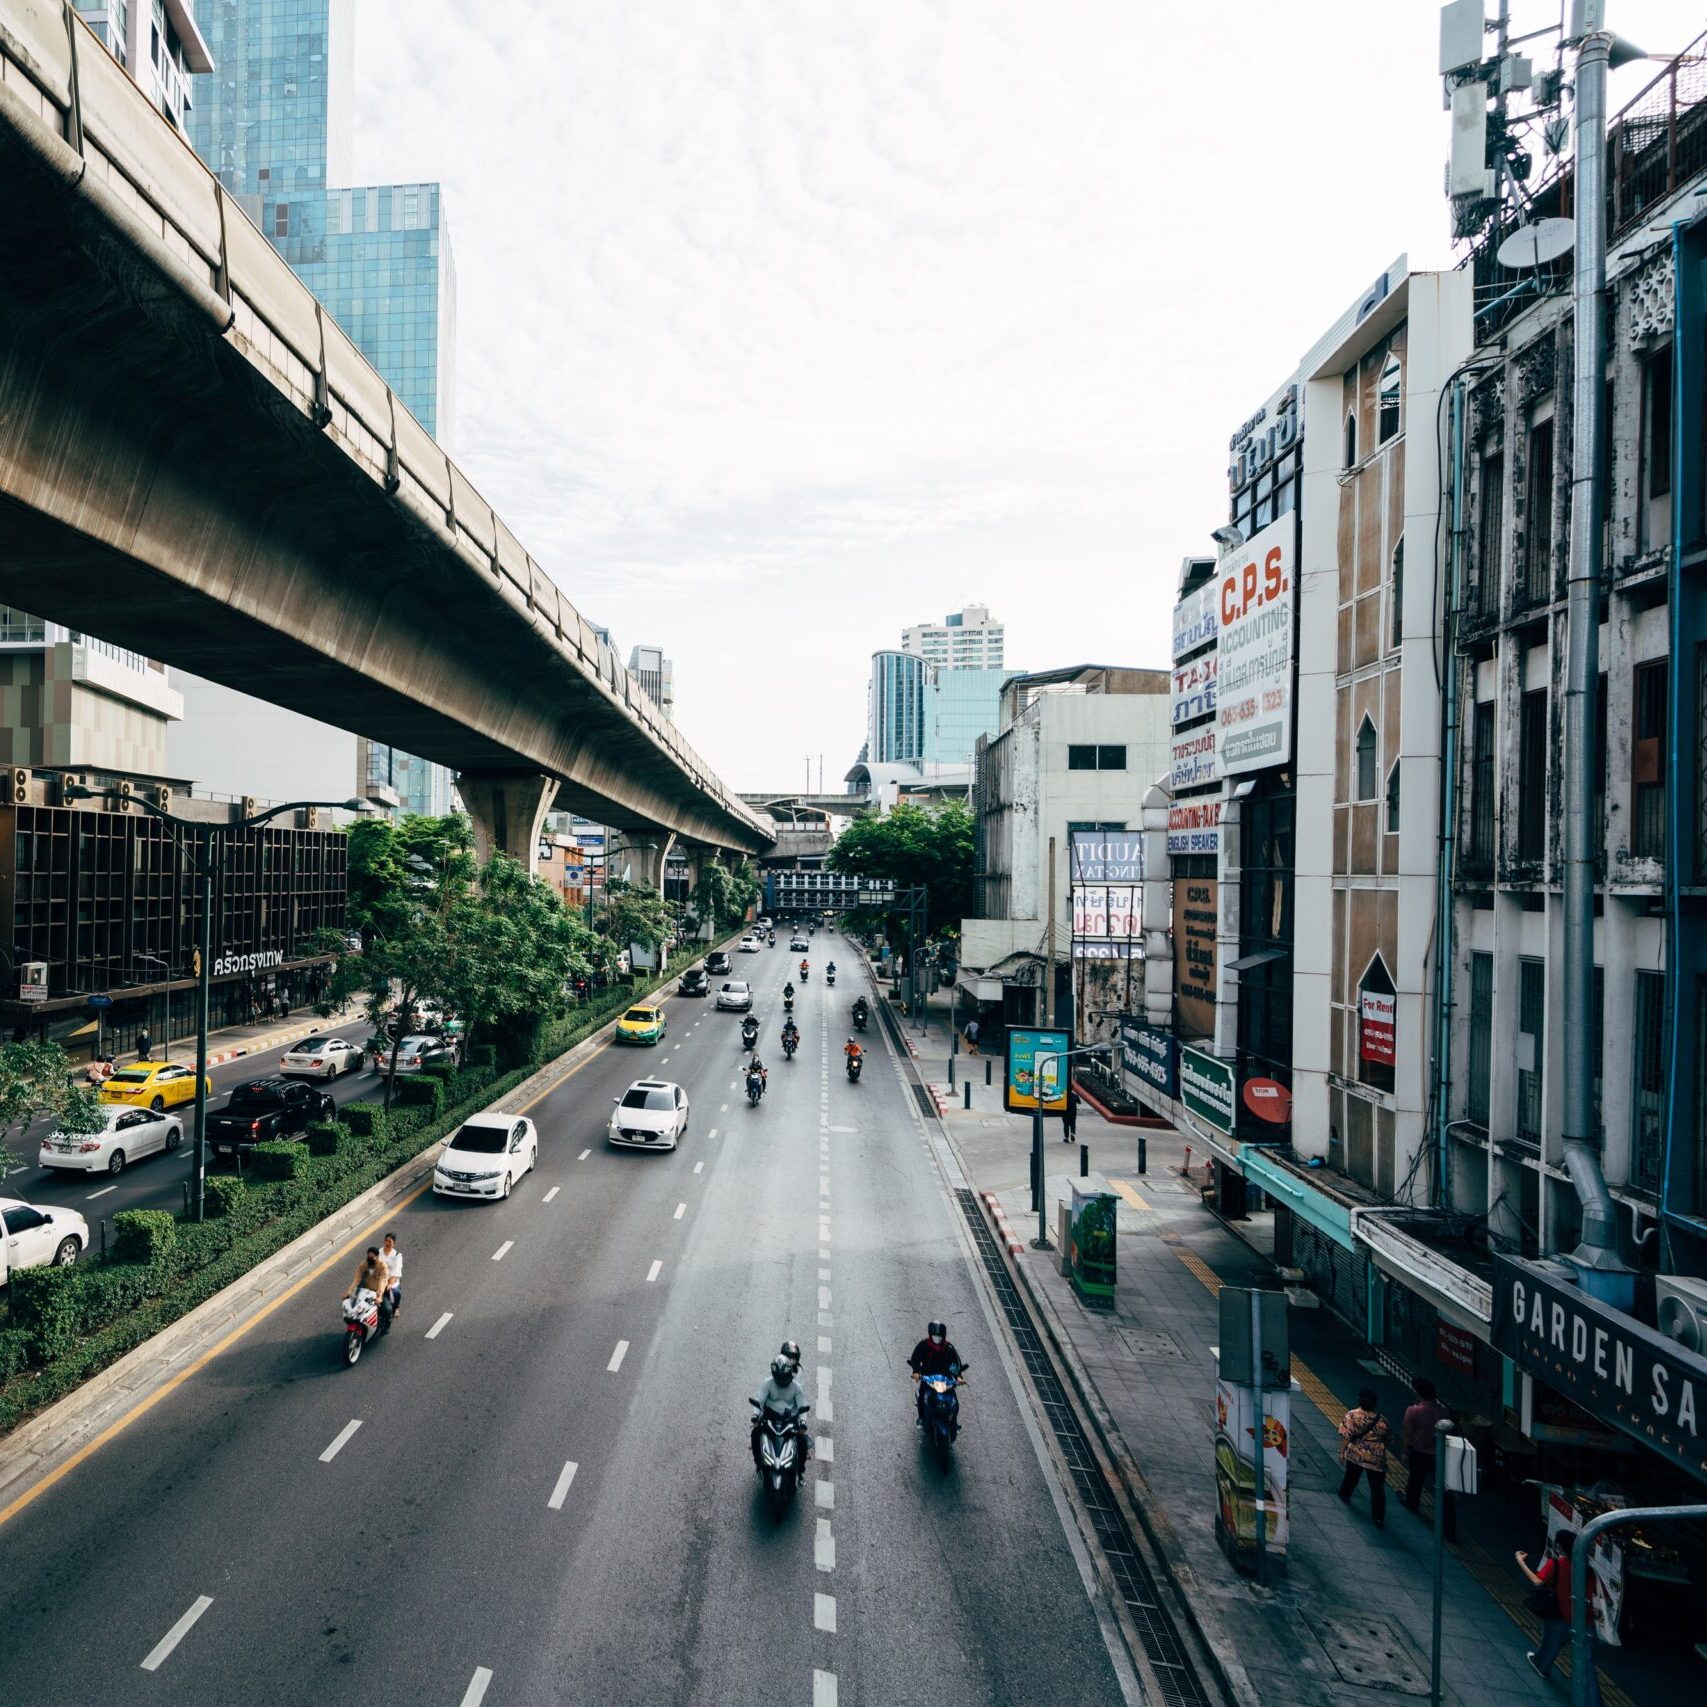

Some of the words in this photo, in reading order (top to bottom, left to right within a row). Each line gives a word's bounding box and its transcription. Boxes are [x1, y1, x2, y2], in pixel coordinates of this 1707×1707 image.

[1221, 545, 1289, 626] C.P.S.
[1219, 601, 1289, 656] ACCOUNTING
[1168, 834, 1190, 852] ENGLISH
[1191, 833, 1218, 851] SPEAKER
[213, 949, 284, 978] ครัวกรุงเทพ
[1363, 998, 1375, 1011] For
[1376, 1000, 1393, 1014] Rent
[1513, 1280, 1633, 1396] GARDEN
